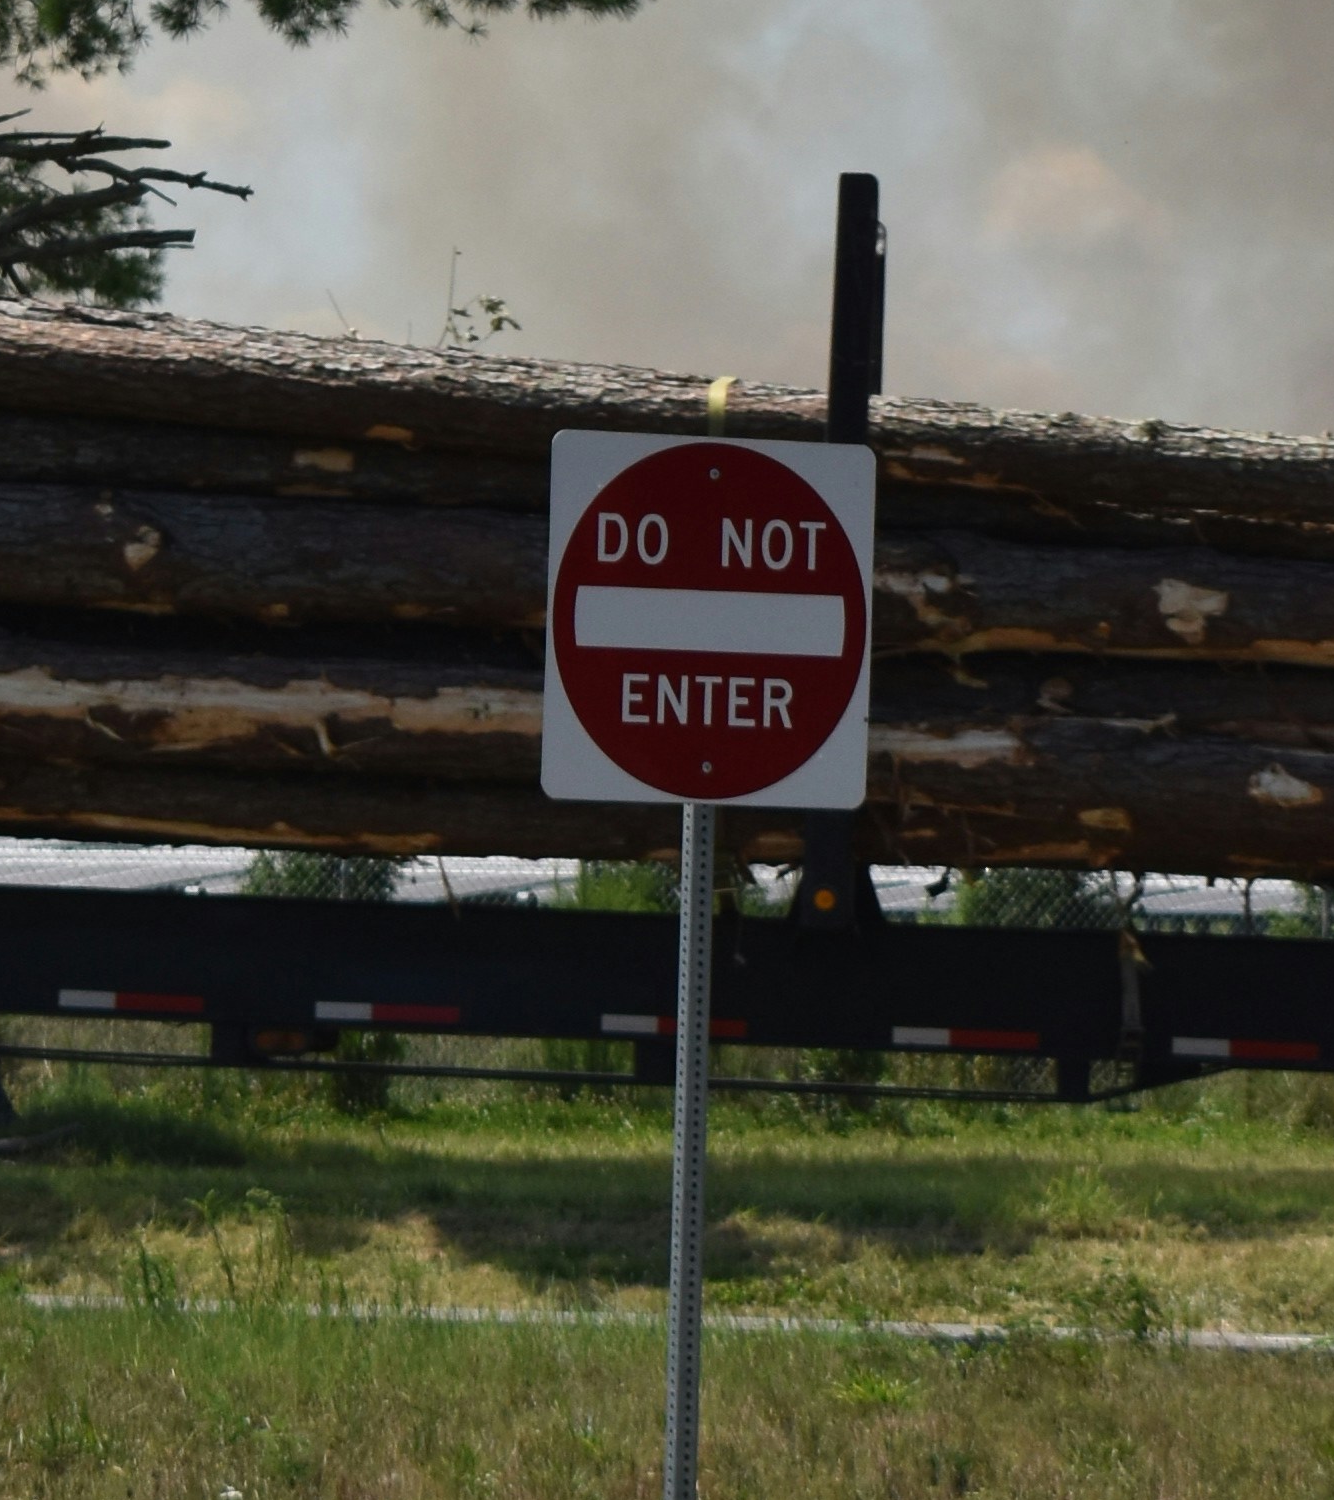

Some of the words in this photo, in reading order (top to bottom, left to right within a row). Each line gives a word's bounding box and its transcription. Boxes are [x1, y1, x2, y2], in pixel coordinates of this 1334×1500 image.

[597, 512, 668, 565] DO
[721, 517, 827, 571] NOT
[621, 673, 794, 729] ENTER
